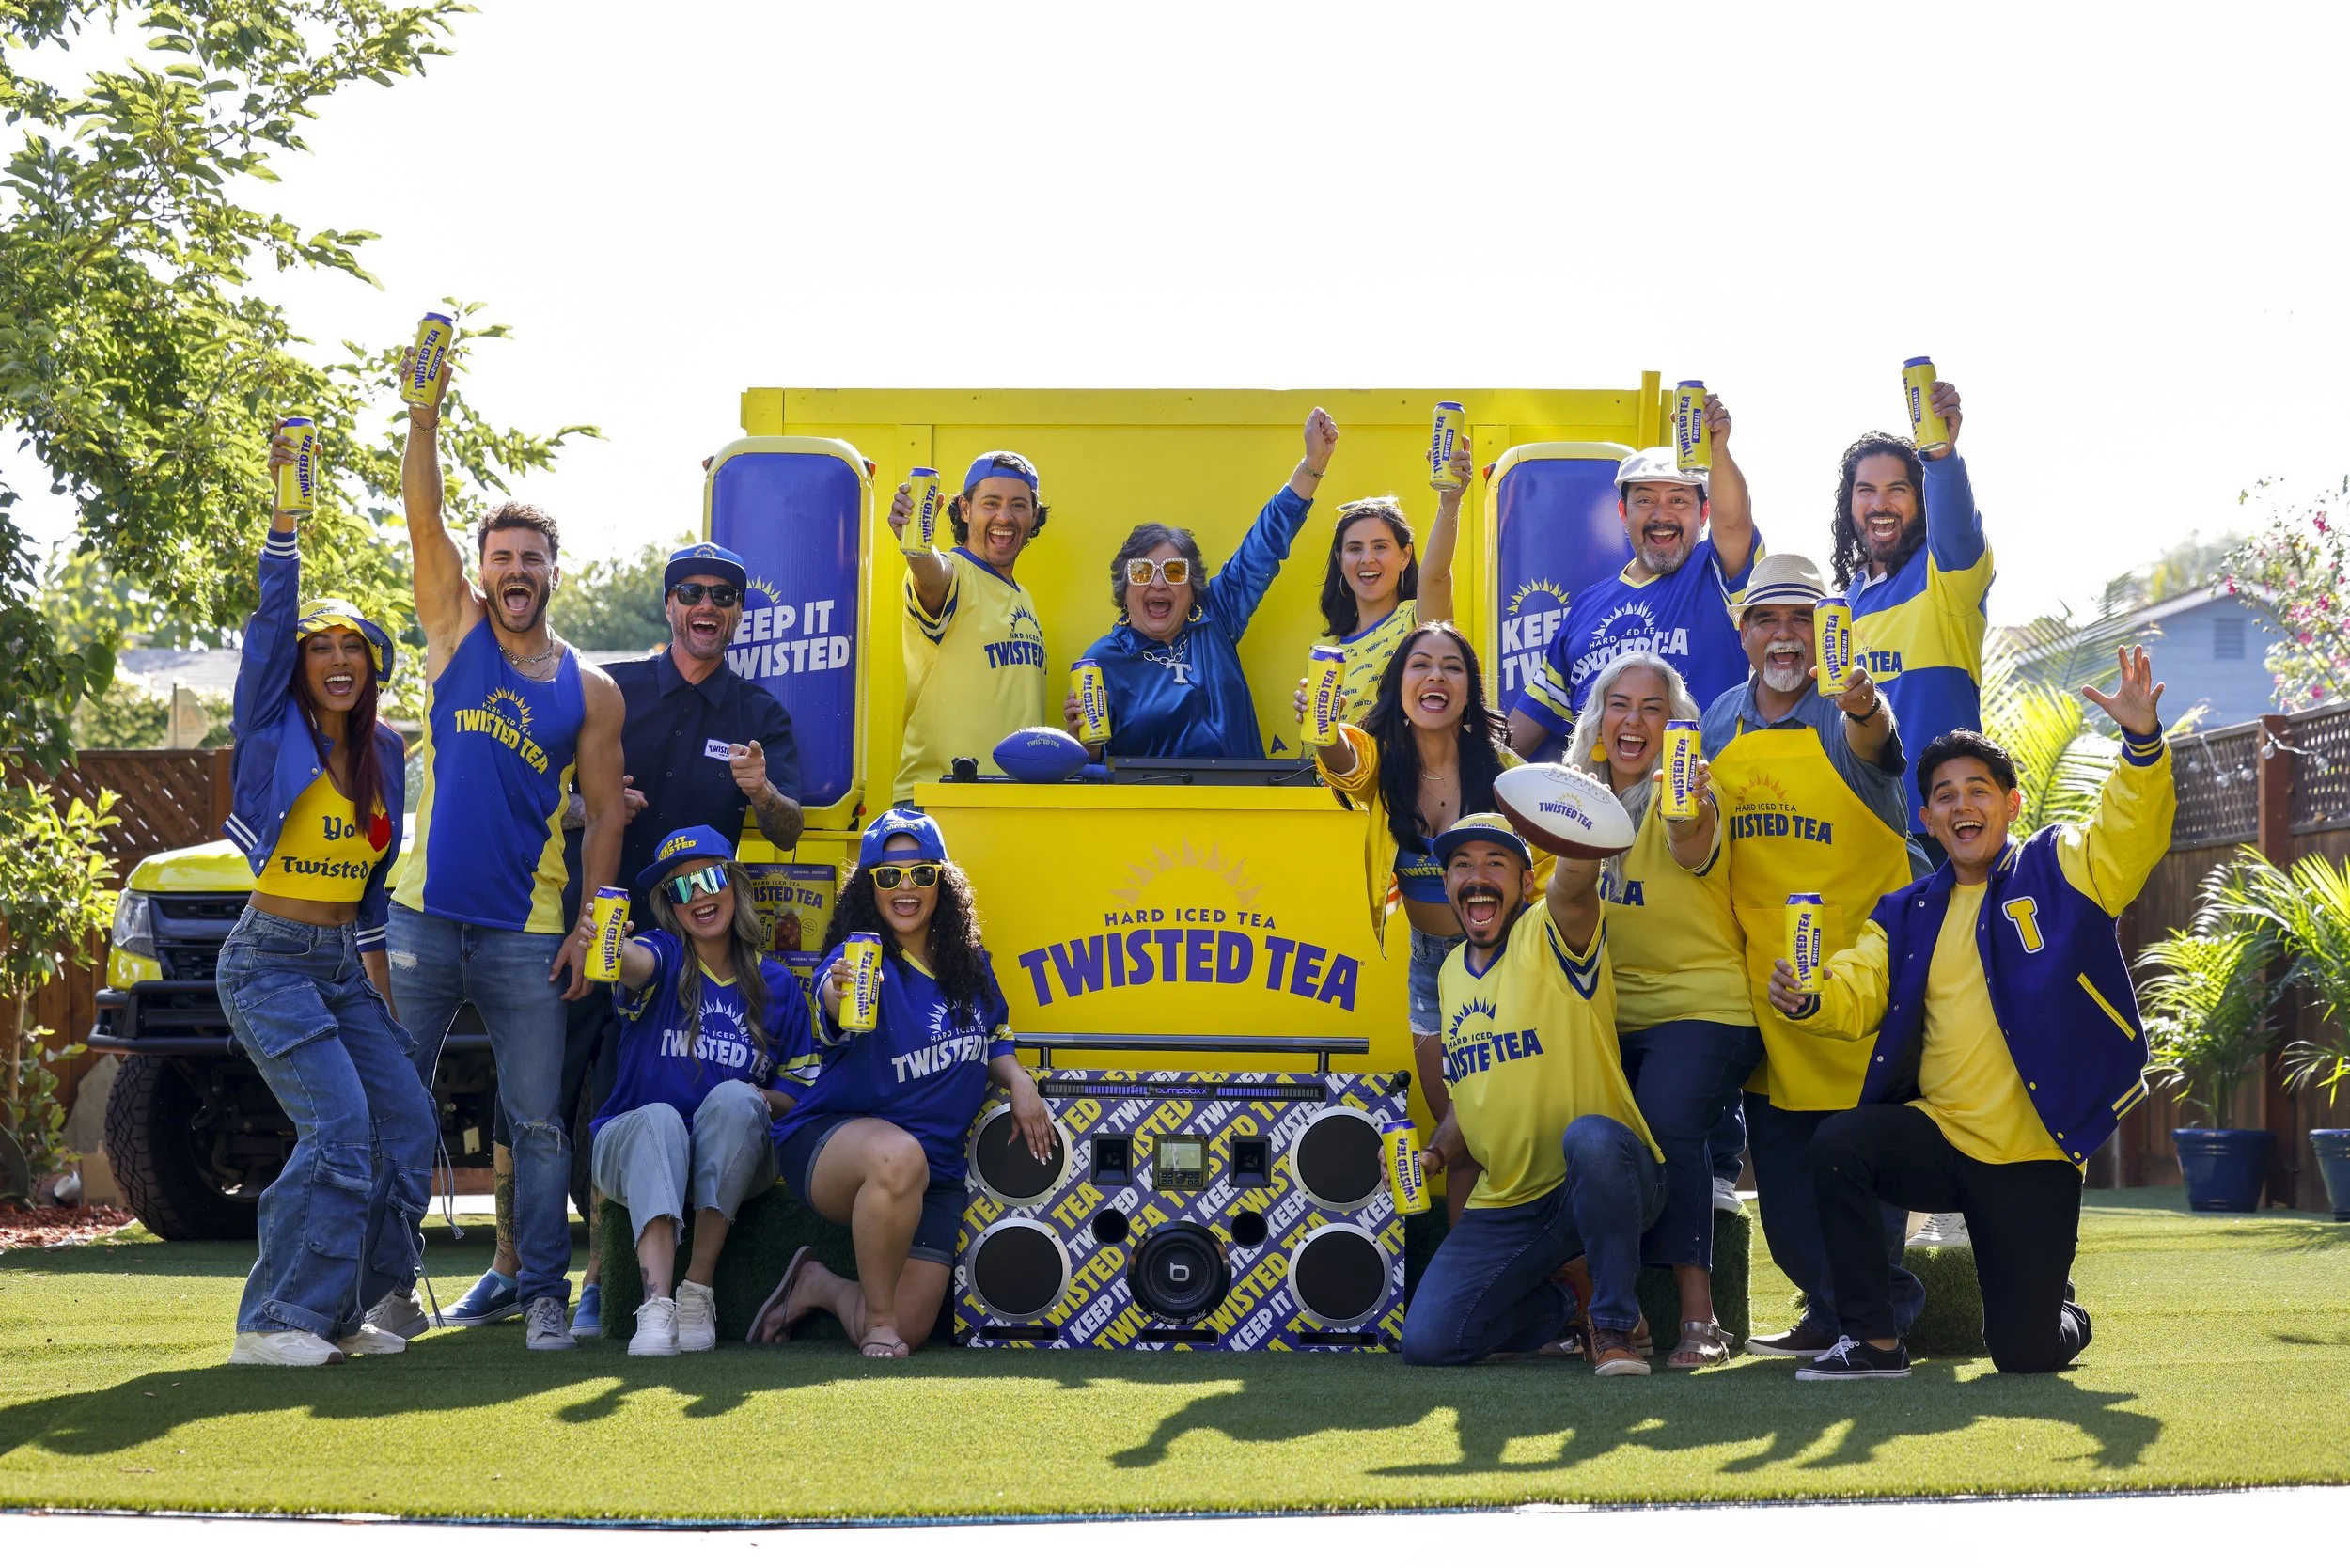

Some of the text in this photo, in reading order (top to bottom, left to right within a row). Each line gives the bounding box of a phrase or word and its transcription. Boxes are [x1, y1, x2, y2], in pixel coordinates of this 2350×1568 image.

[415, 348, 431, 390] TWISTED
[424, 329, 441, 347] TEA
[429, 349, 444, 377] ORIGINAL
[301, 434, 313, 453] TEA
[1679, 396, 1693, 457] TWISTED TEA
[1433, 416, 1446, 474] TWISTED TEA
[1444, 431, 1452, 457] ORIGINAL
[299, 454, 311, 498] TWISTED
[926, 485, 937, 502] TEA
[922, 502, 932, 543] TWISTED
[730, 600, 835, 646] EEP IT
[1502, 607, 1572, 655] KEE
[725, 635, 850, 680] WISTED
[984, 641, 1044, 669] TWISTED
[1589, 635, 1617, 650] HARD
[1825, 615, 1842, 681] TWISTED TEA
[1869, 651, 1903, 673] TEA
[1083, 674, 1094, 691] TEA
[482, 701, 532, 737] HARD TEA
[1083, 692, 1101, 729] TWISTED
[1317, 669, 1337, 735] TWISTED TEA
[1331, 688, 1341, 718] ORIGINAL
[455, 709, 549, 775] TWISTED TEA
[708, 745, 729, 754] TWISTE
[1026, 739, 1060, 749] TWISTED TEA
[1271, 735, 1288, 754] A
[1673, 739, 1690, 806] TWISTED TEA
[1688, 758, 1697, 788] ORIGINAL
[1539, 803, 1593, 831] TWISTED TEA
[1735, 804, 1756, 812] HARD
[1779, 804, 1797, 812] TEA
[675, 835, 686, 844] IT
[1730, 814, 1832, 845] ISTED TEA
[280, 857, 368, 880] Twisted
[1399, 867, 1444, 876] TWISTE
[754, 886, 822, 909] ISTED TEA
[1104, 908, 1276, 930] HARD ICED TEA
[2003, 897, 2044, 952] T
[604, 907, 624, 971] TWISTED TEA
[1796, 913, 1812, 981] TWISTED TEA
[856, 951, 874, 1018] TWISTED TEA
[1018, 929, 1359, 1013] TWISTED TEA
[713, 1031, 736, 1040] ICED
[931, 1030, 952, 1043] HARD
[956, 1026, 976, 1035] ICED
[1448, 1032, 1493, 1050] HARD ICED
[1491, 1029, 1543, 1062] TEA
[891, 1035, 982, 1083] TWISTED
[1397, 1138, 1418, 1203] TWISTED TEA
[1050, 1181, 1105, 1230] TEA
[1355, 1190, 1395, 1231] KEE
[1377, 1218, 1405, 1256] TE
[1069, 1278, 1132, 1344] KEEP IT
[1150, 1309, 1207, 1325] XTREME BASS
[1229, 1308, 1273, 1352] KEEP
[1270, 1290, 1292, 1317] IT
